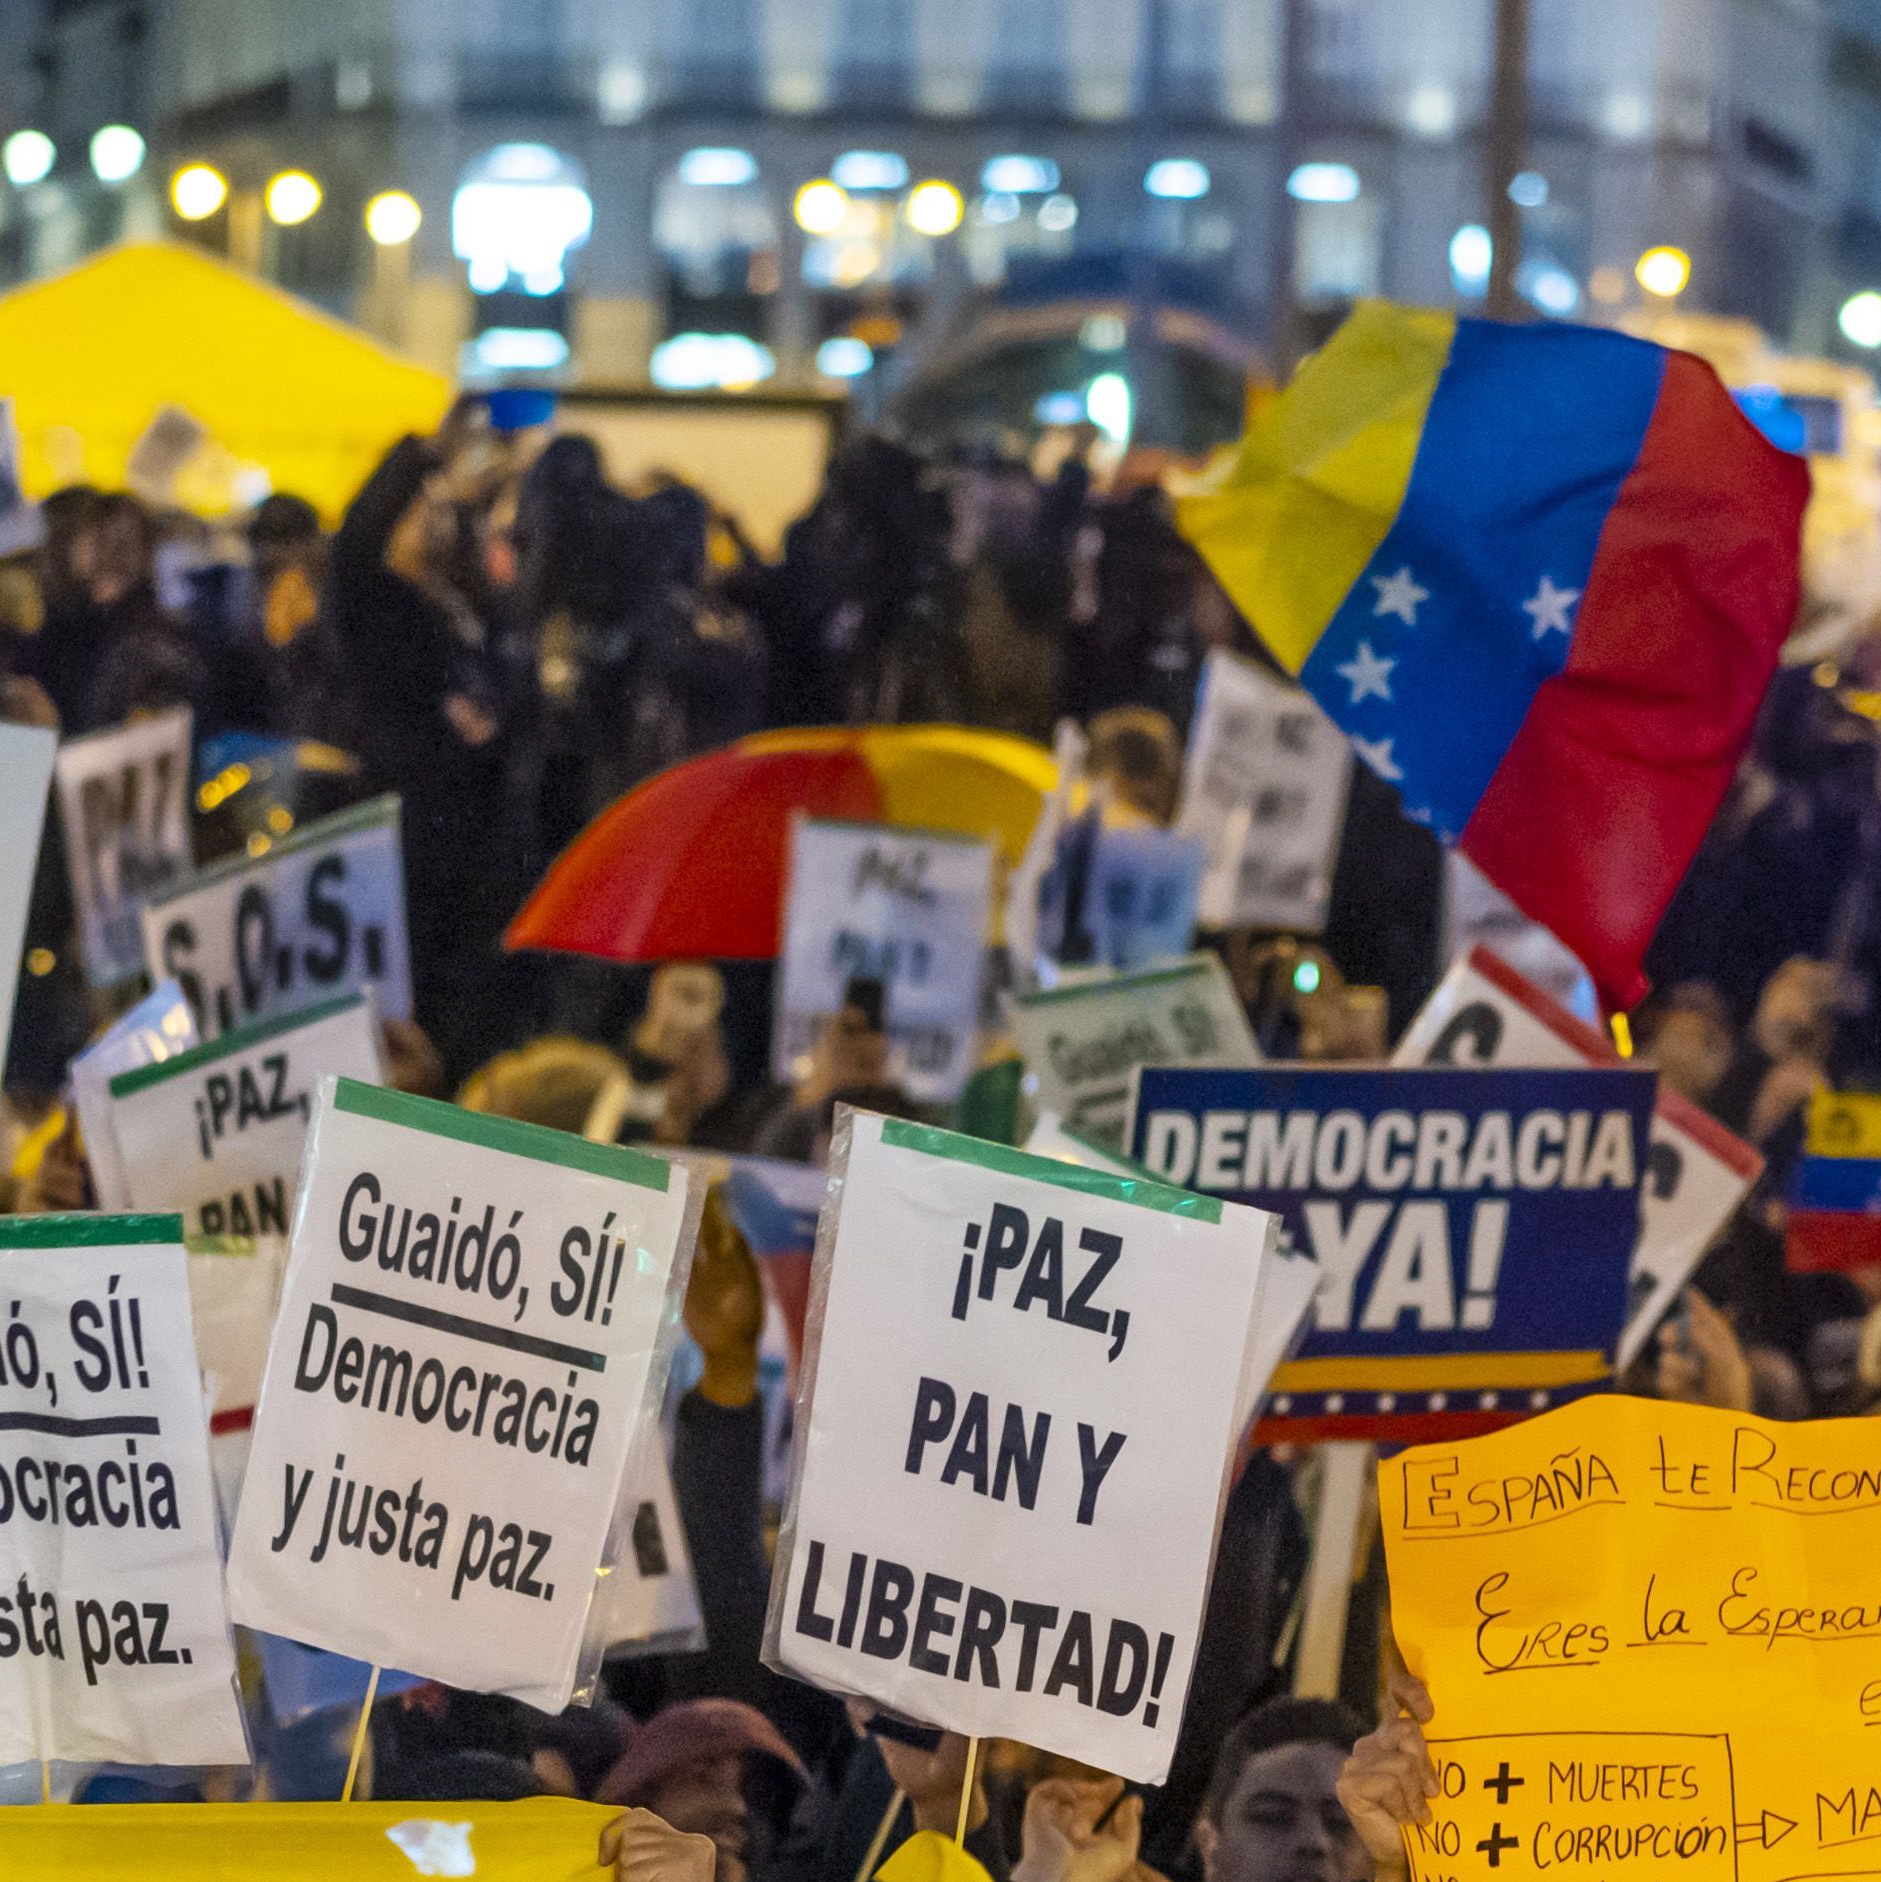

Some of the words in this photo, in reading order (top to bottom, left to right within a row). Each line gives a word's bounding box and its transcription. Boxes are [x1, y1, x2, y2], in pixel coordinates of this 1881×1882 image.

[194, 1054, 311, 1160] ¡PAZ,
[1142, 1108, 1636, 1194] DEMOCRACIA
[337, 1171, 531, 1323] Guaidó,
[549, 1211, 626, 1327] SÍ!
[952, 1202, 1131, 1365] ¡PAZ,
[1302, 1199, 1510, 1333] YA!
[72, 1274, 150, 1394] SÍ!
[294, 1300, 601, 1467] Democracia
[904, 1376, 1052, 1514] PAN
[1074, 1420, 1128, 1528] Y
[1403, 1446, 1620, 1531] ESPAÑA
[271, 1461, 314, 1553] y
[310, 1453, 447, 1571] justa
[450, 1511, 558, 1601] paz.
[78, 1596, 194, 1686] paz.
[793, 1539, 1177, 1731] LIBERTAD!
[1642, 1573, 1691, 1642] la
[1417, 1820, 1461, 1858] NO
[1548, 1760, 1700, 1805] MUERTES
